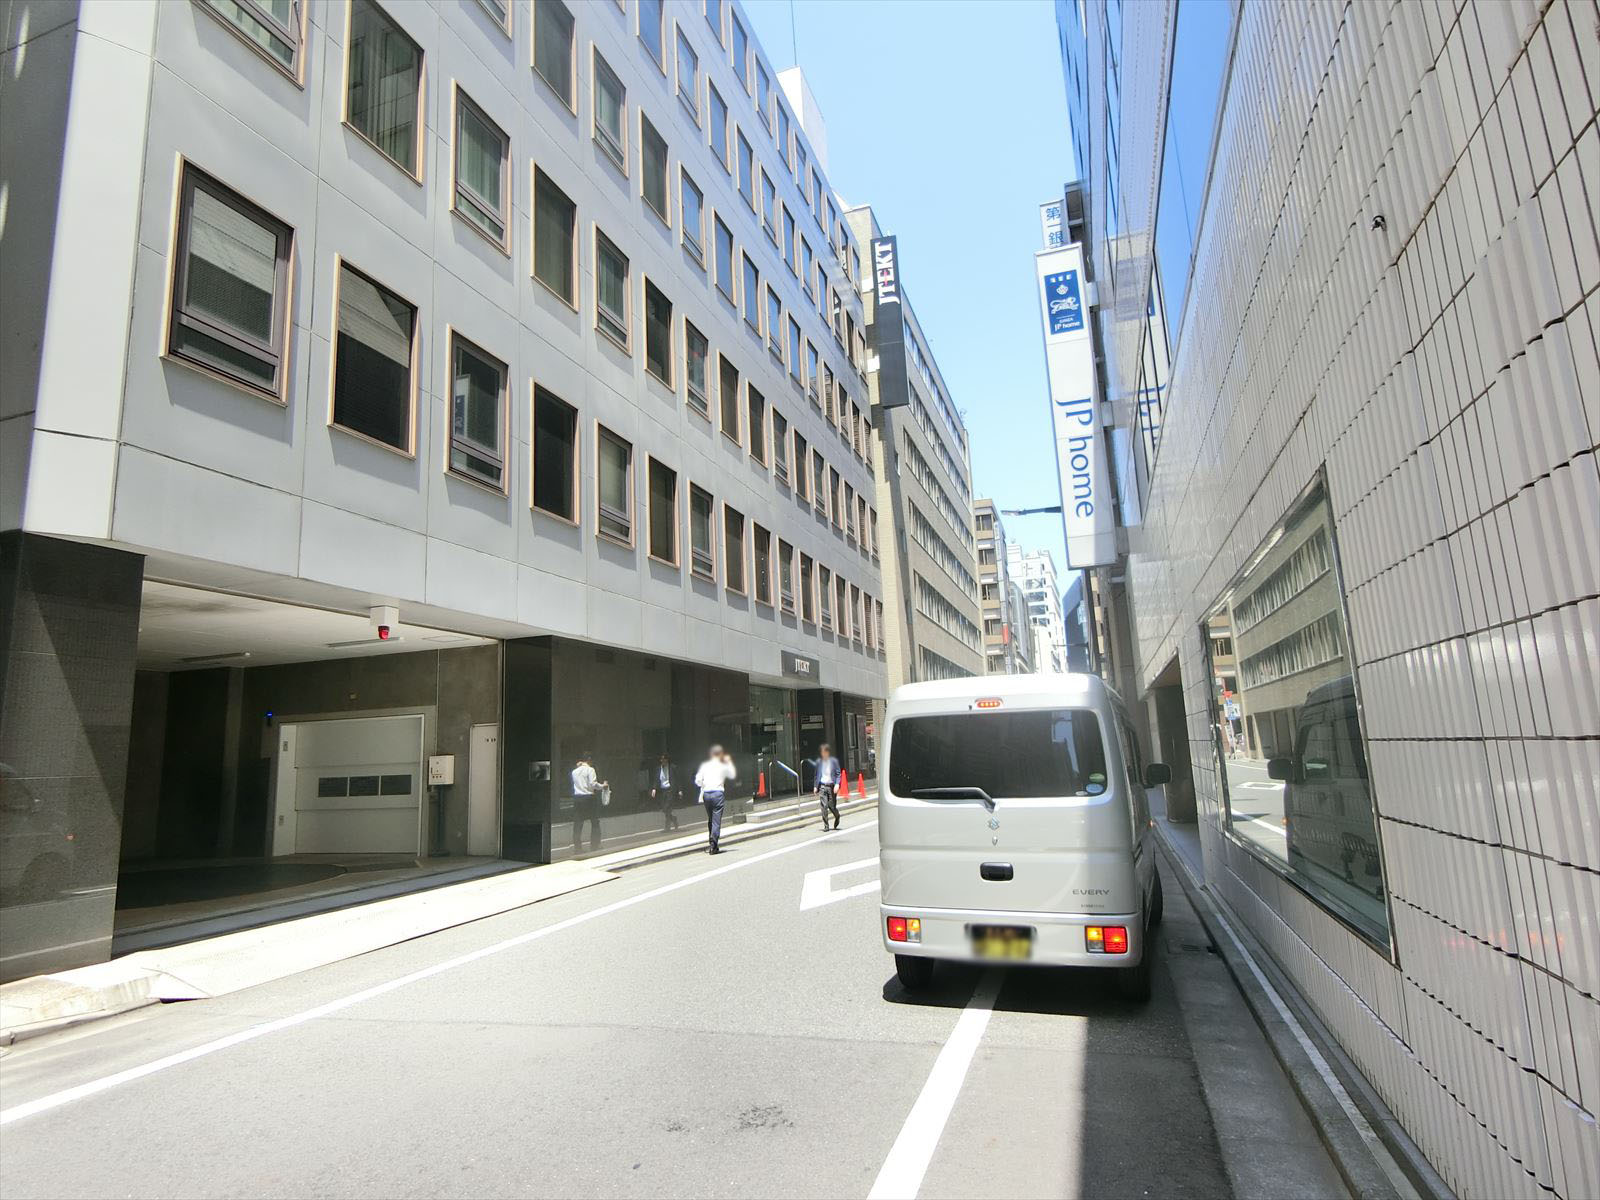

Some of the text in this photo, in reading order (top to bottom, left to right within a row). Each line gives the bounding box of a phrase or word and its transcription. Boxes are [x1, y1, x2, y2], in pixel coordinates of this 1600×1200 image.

[1046, 207, 1064, 249] 第一銀
[874, 242, 900, 305] JTEKT
[1055, 397, 1094, 518] JP home
